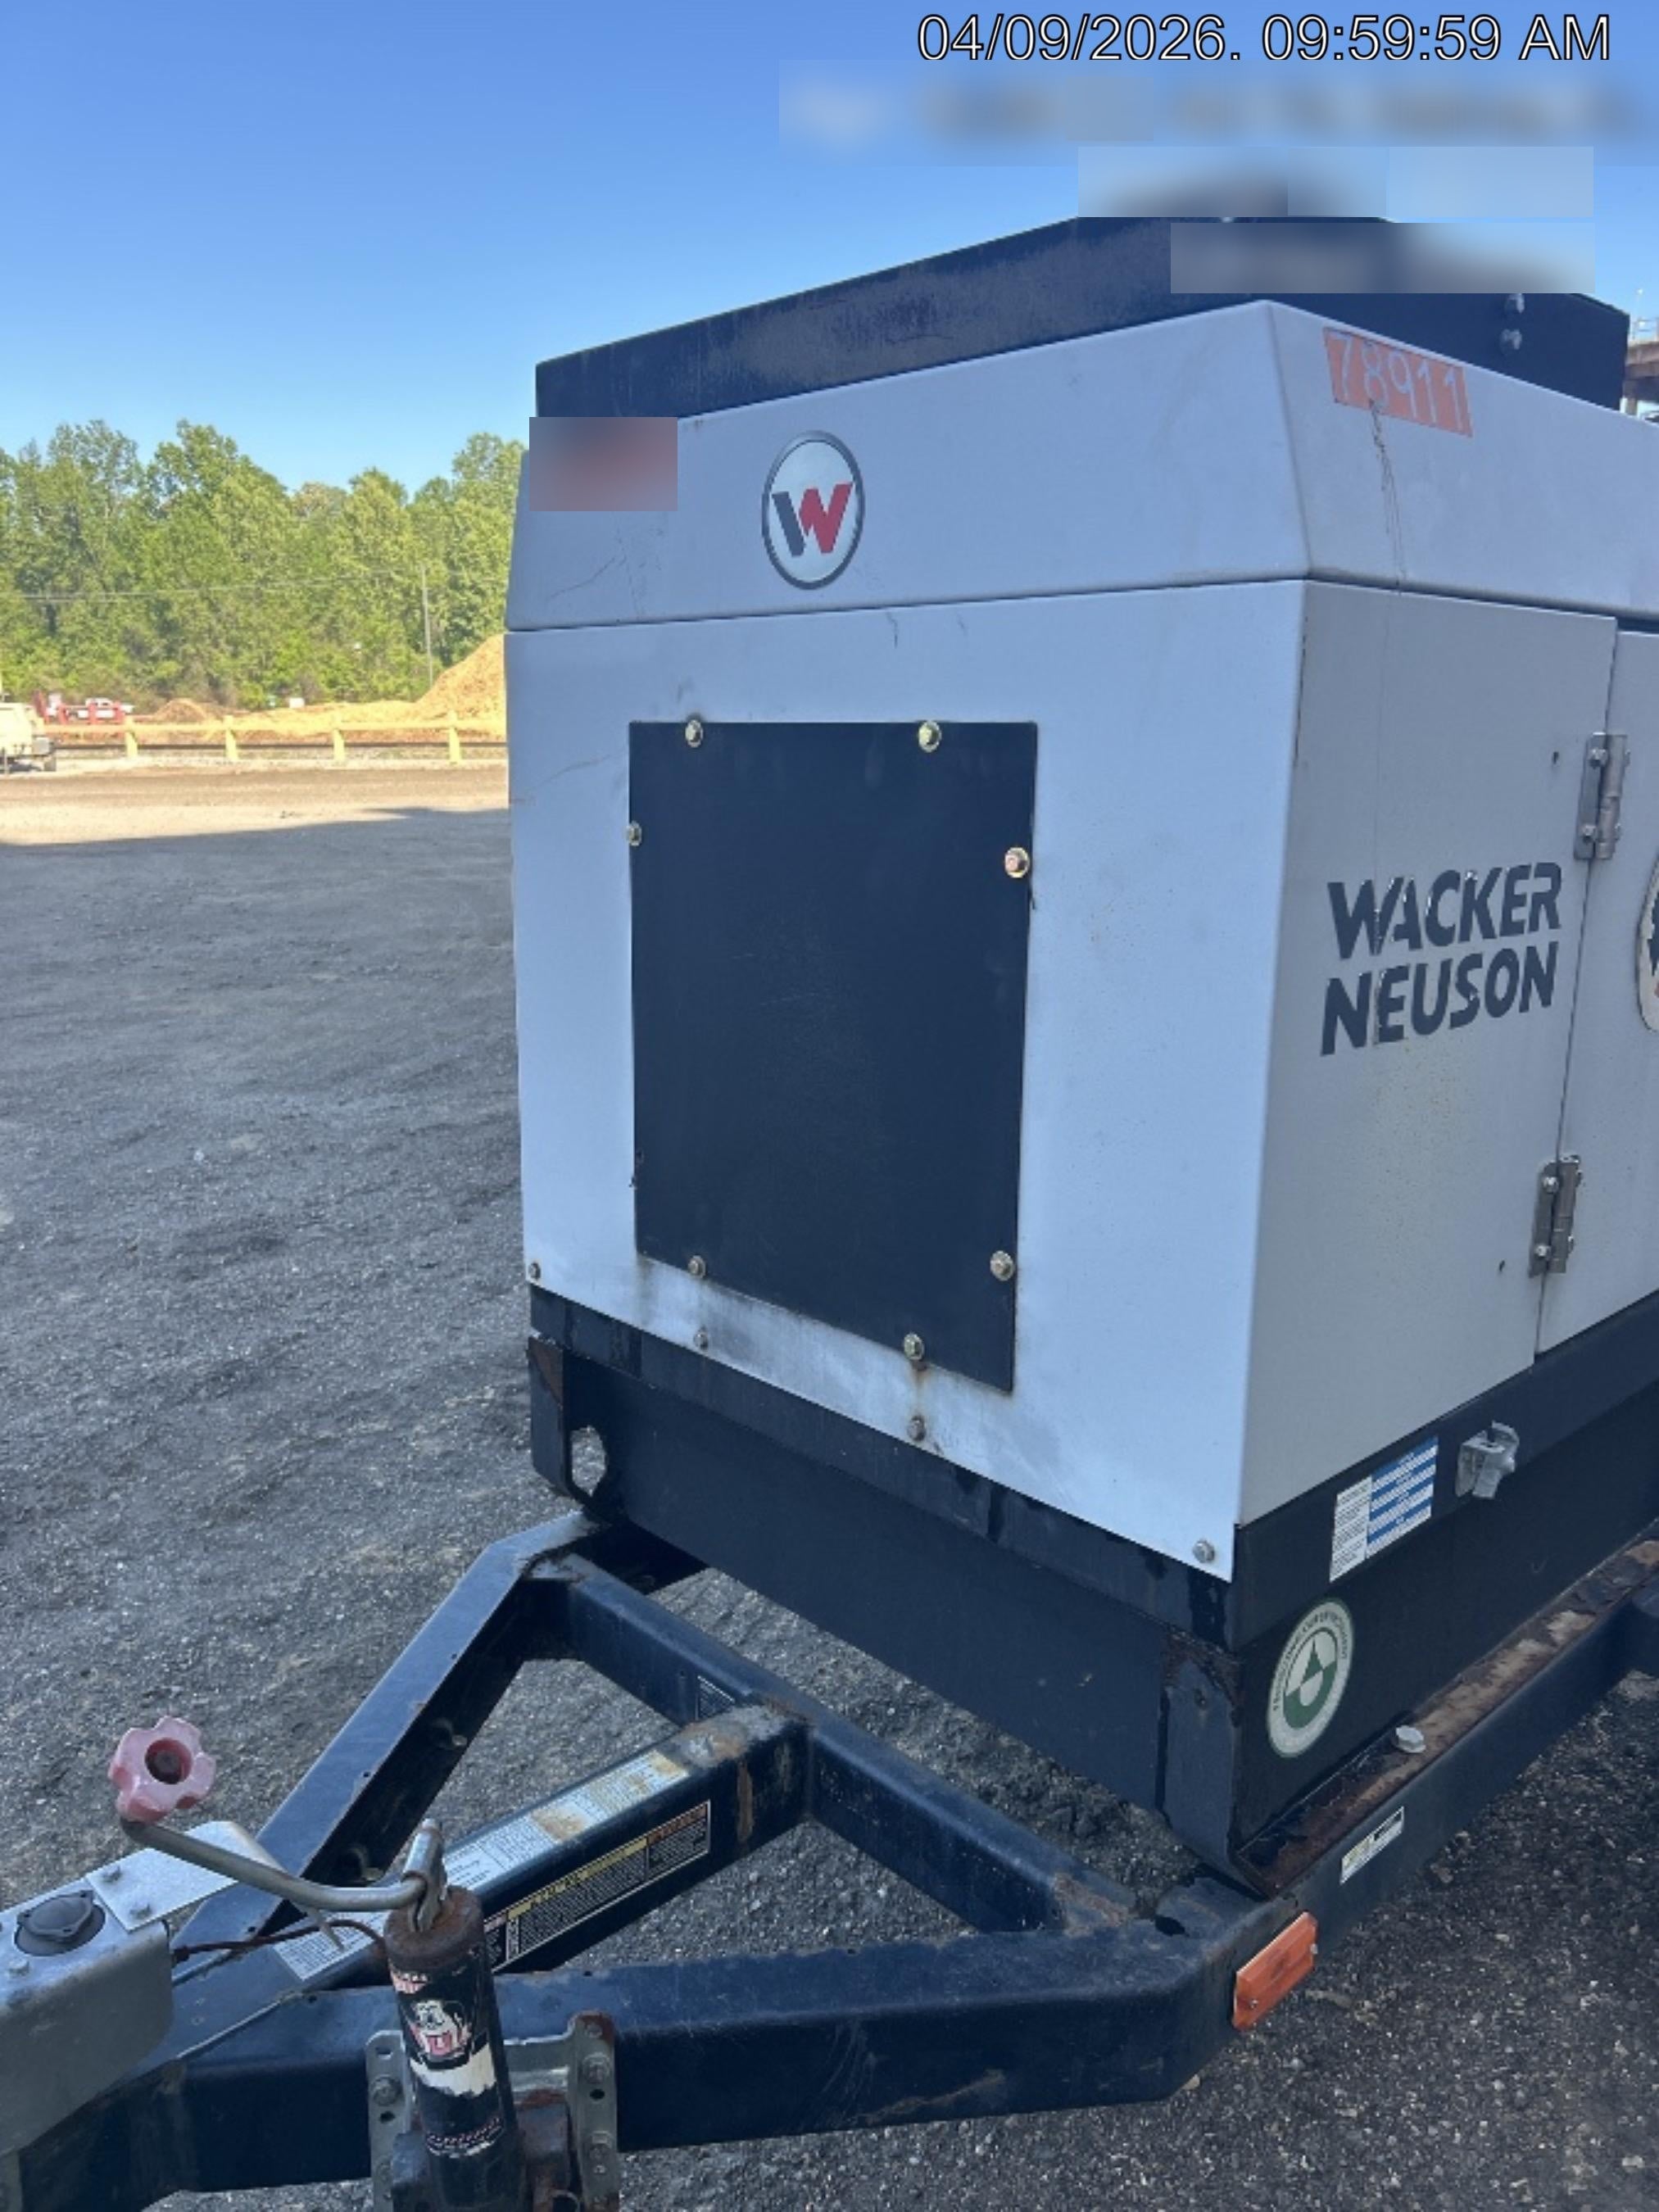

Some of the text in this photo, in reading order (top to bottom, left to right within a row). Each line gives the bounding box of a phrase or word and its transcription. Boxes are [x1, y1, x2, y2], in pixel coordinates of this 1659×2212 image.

[1326, 331, 1465, 432] 78911
[1326, 862, 1562, 959] WACKER
[1320, 941, 1560, 1057] NEUSON
